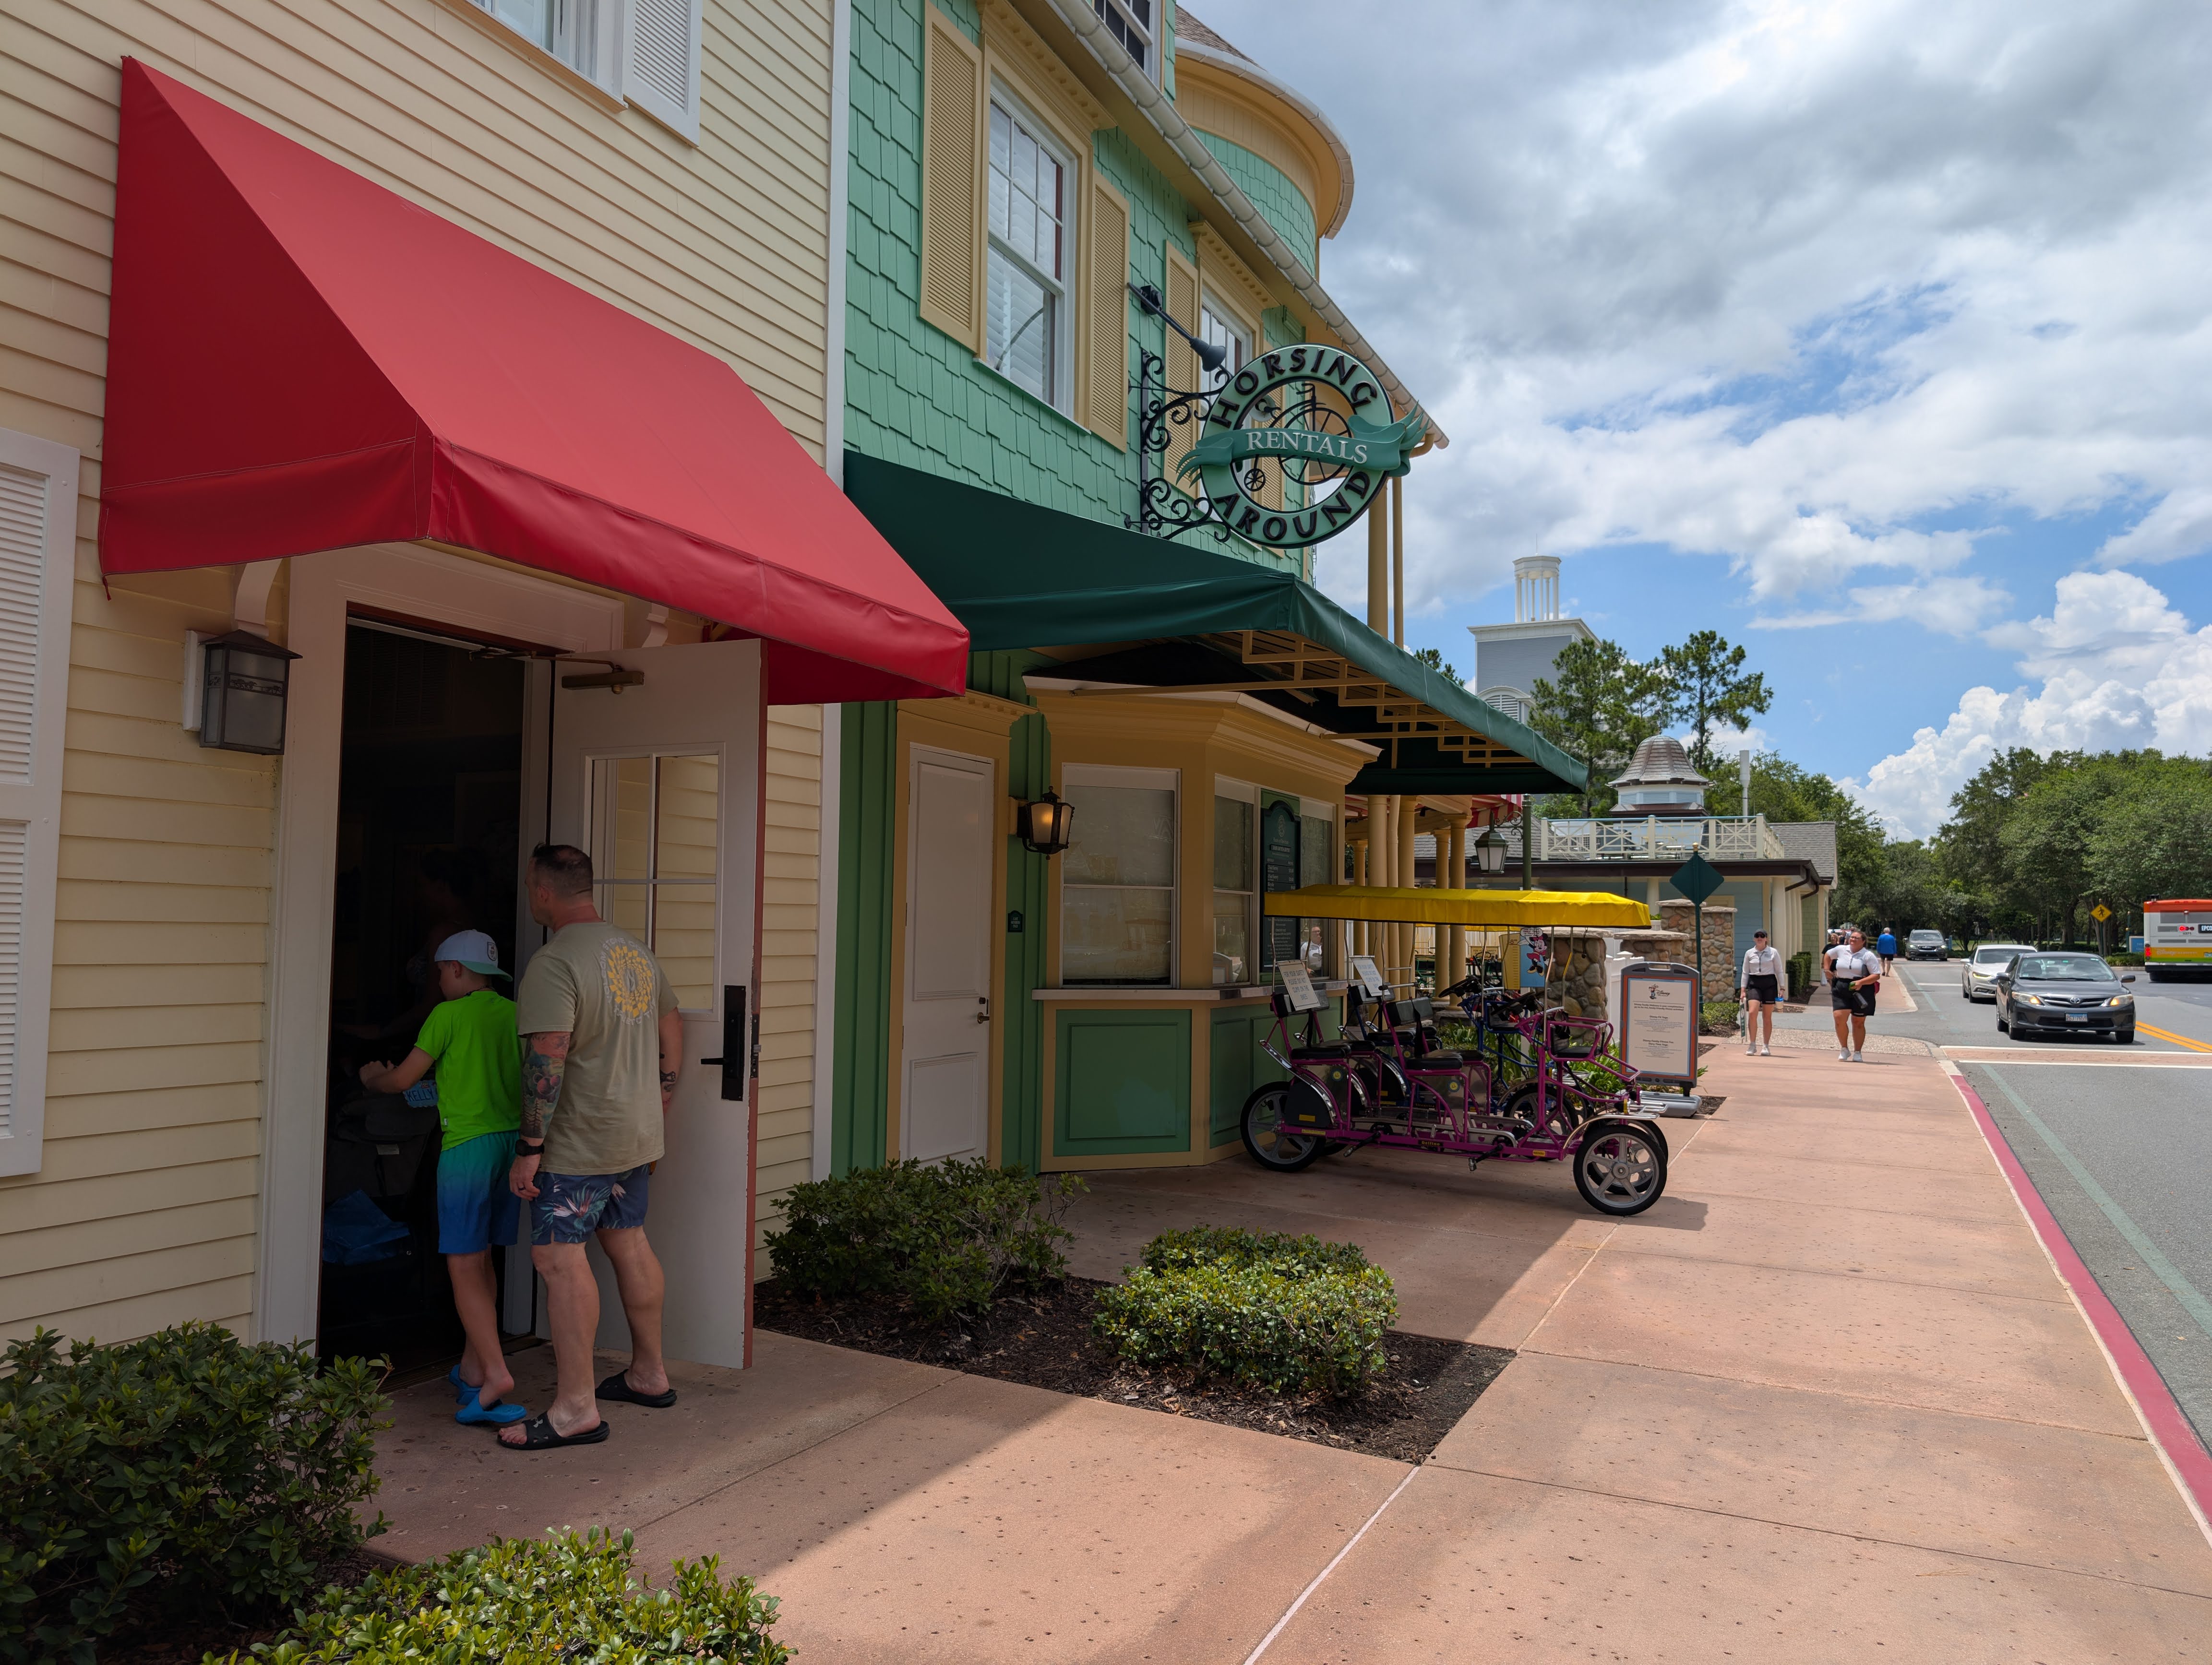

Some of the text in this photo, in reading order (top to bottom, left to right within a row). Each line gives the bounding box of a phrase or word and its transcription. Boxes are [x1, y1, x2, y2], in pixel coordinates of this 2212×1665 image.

[1209, 347, 1377, 428] HORSING
[1246, 431, 1368, 464] RENTALS
[1213, 471, 1371, 541] AROUND
[602, 937, 626, 951] STONE
[406, 1088, 434, 1102] KELLY
